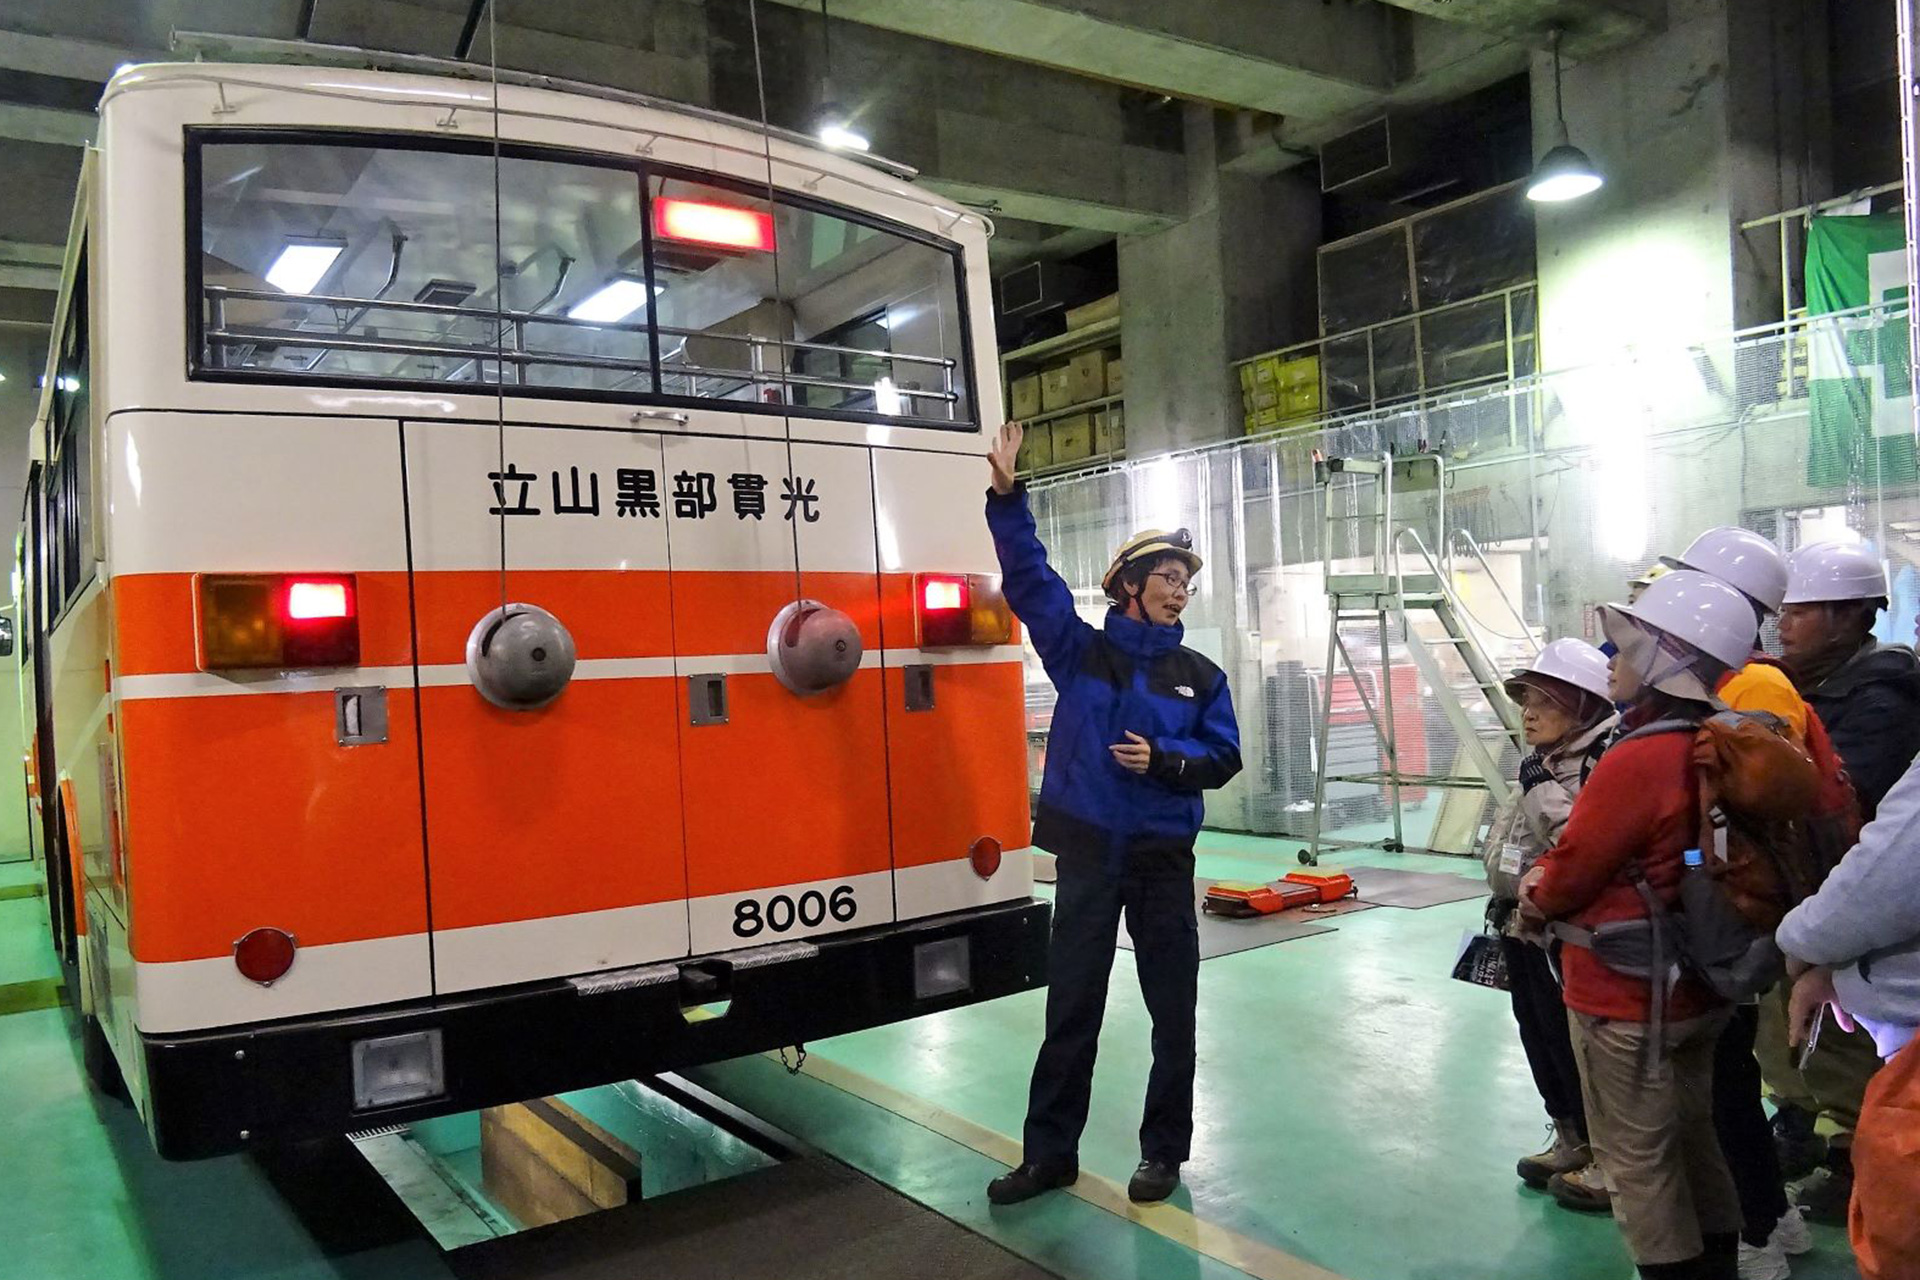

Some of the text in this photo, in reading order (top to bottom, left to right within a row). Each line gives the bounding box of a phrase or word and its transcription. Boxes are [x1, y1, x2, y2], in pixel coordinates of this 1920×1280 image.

[487, 463, 820, 523] 立山黒部貫光
[732, 885, 857, 938] 8006
